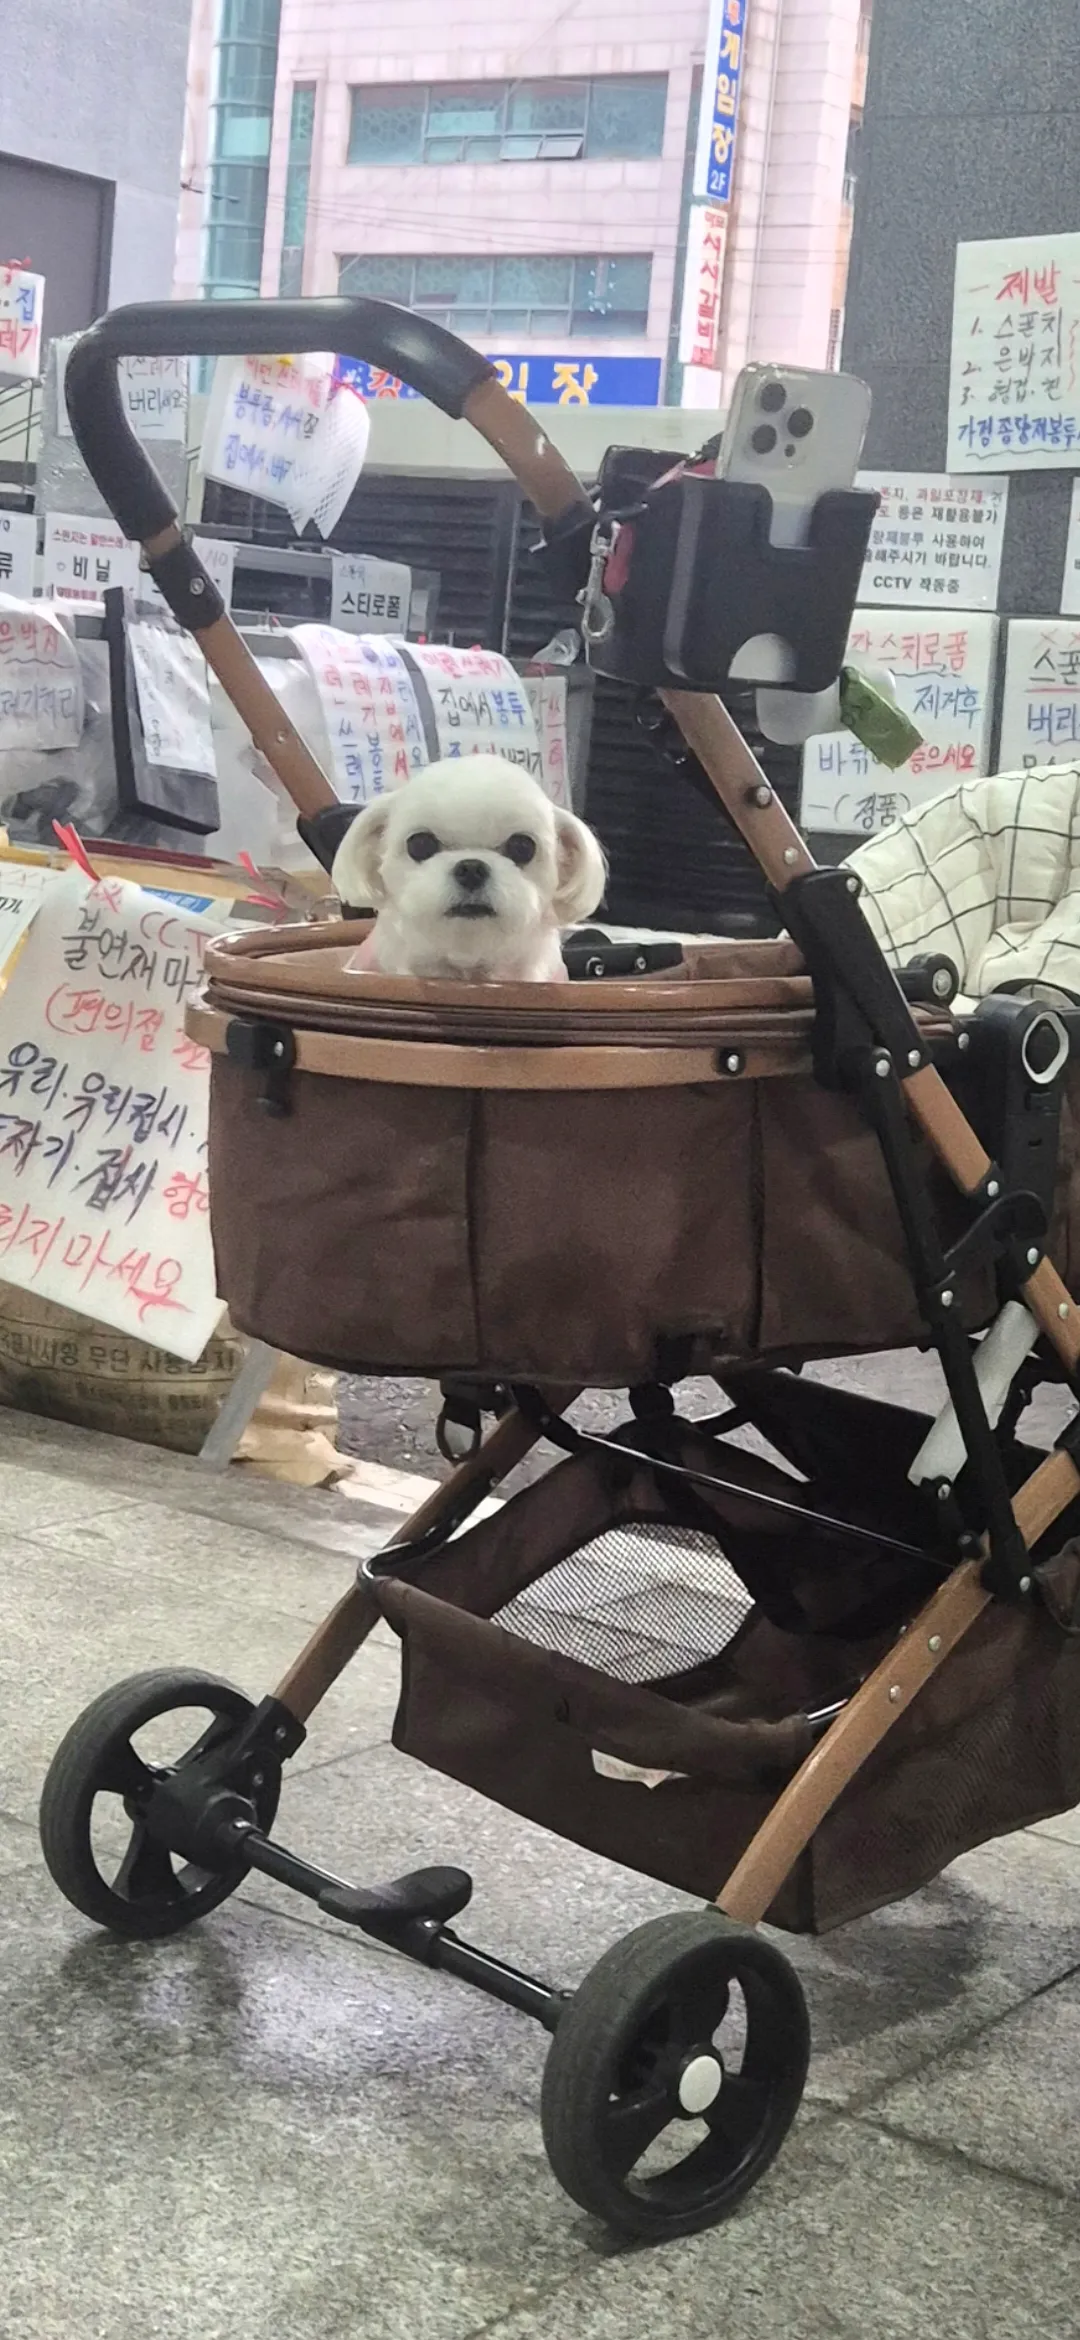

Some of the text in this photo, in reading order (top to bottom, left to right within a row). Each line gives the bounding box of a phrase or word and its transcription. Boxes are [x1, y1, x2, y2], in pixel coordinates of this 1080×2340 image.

[711, 170, 727, 191] 2F
[995, 259, 1061, 304] 제발
[872, 530, 986, 550] 량제봉투 사용하여
[73, 555, 111, 582] 비닐
[872, 575, 913, 590] CCTV
[340, 591, 401, 619] 스티로폼
[140, 910, 214, 958] CC.T
